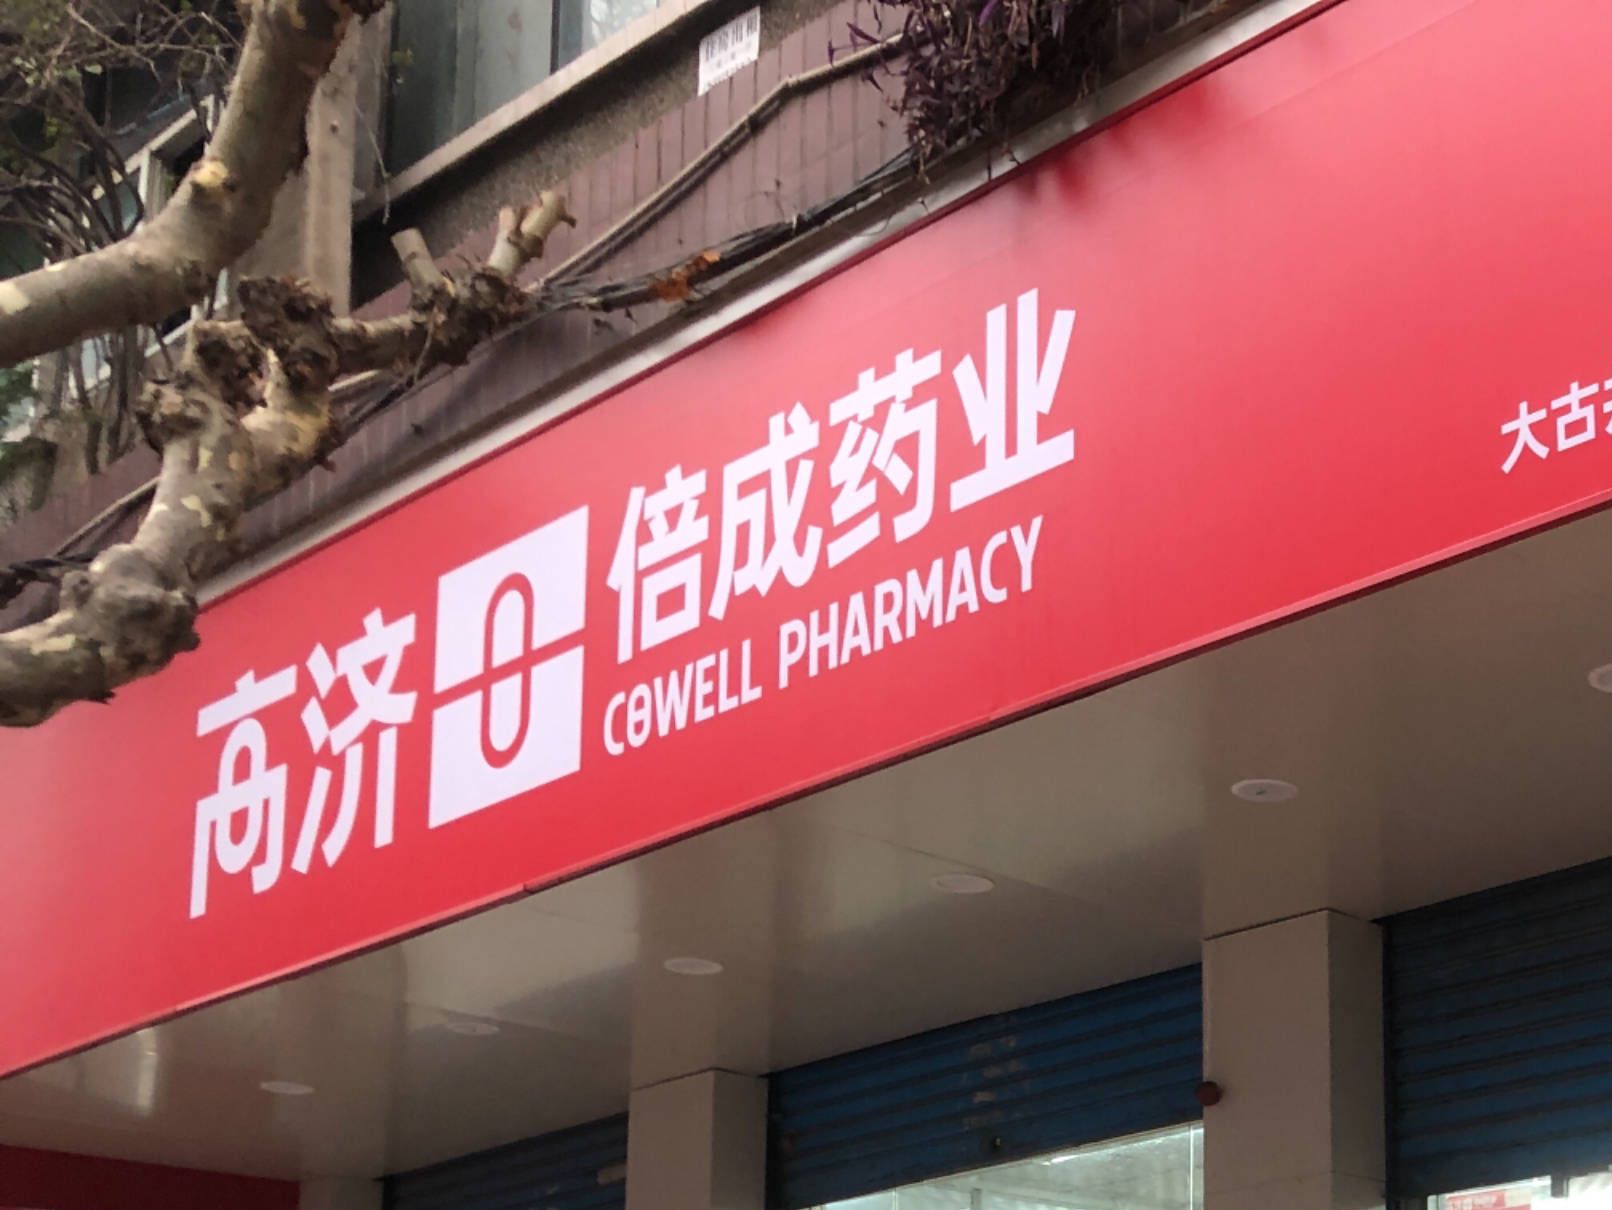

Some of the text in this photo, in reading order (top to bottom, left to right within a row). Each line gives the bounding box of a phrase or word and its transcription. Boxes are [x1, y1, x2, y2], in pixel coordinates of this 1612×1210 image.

[190, 287, 1077, 920] 高济 倍成药业
[603, 516, 1044, 756] COWELL PHARMACY
